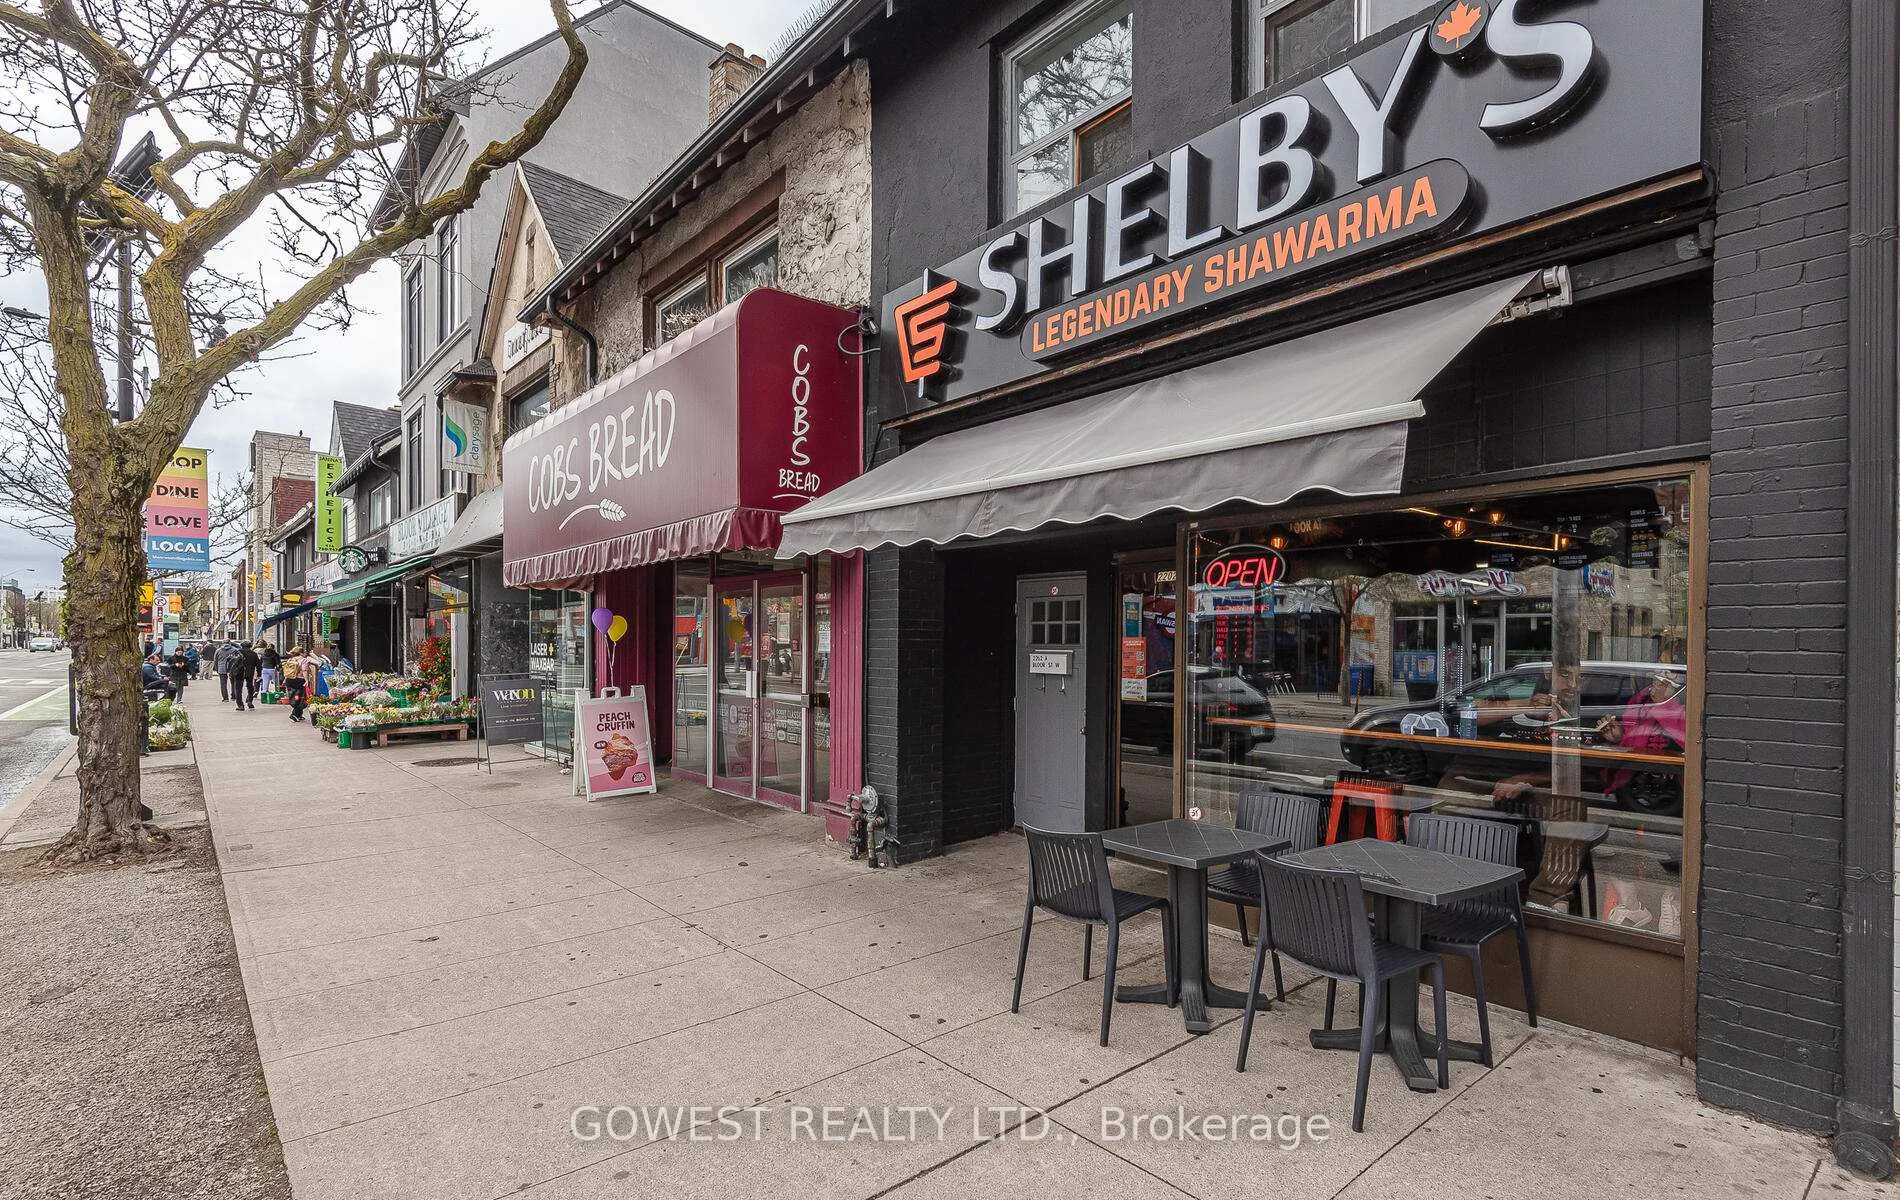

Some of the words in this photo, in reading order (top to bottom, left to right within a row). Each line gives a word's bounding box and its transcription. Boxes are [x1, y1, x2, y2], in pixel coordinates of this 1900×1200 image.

[1031, 264, 1194, 354] LEGENDARY
[1203, 176, 1438, 294] SHAWARMA
[790, 343, 811, 466] COBS
[470, 411, 484, 461] clarysage
[528, 437, 582, 513] COBS
[588, 389, 677, 493] BREAD
[778, 468, 821, 493] BREAD
[155, 484, 199, 499] DINE
[154, 514, 202, 529] LOVE
[151, 540, 205, 554] LOCAL
[1206, 557, 1278, 588] OPEN
[530, 643, 548, 656] LASER
[530, 657, 556, 672] WAXBAR
[598, 712, 631, 723] PEACH
[596, 720, 636, 732] CRUFFIN
